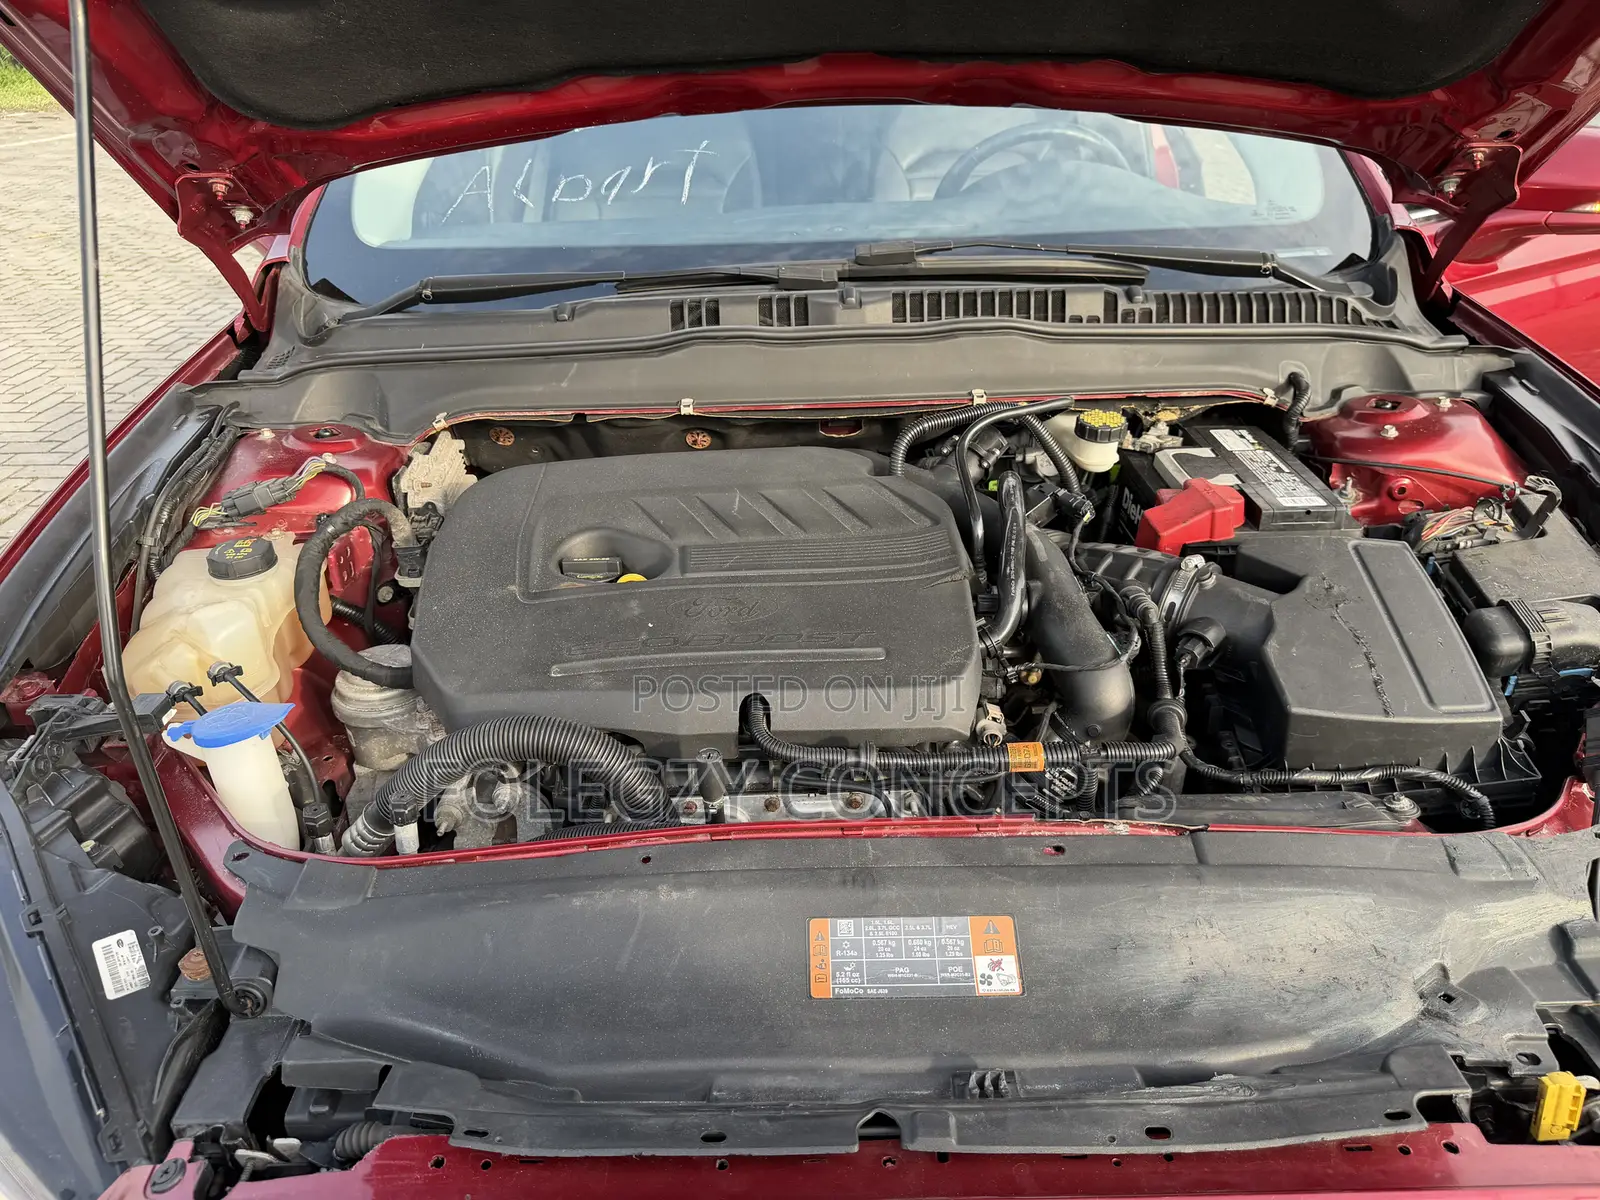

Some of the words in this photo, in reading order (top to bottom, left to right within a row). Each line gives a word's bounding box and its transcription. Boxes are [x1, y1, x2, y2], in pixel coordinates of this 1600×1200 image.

[1122, 486, 1144, 525] DieH
[888, 939, 896, 947] kg
[924, 939, 932, 947] kg
[957, 938, 965, 946] kg
[895, 966, 910, 974] PAG
[947, 965, 964, 973] POE
